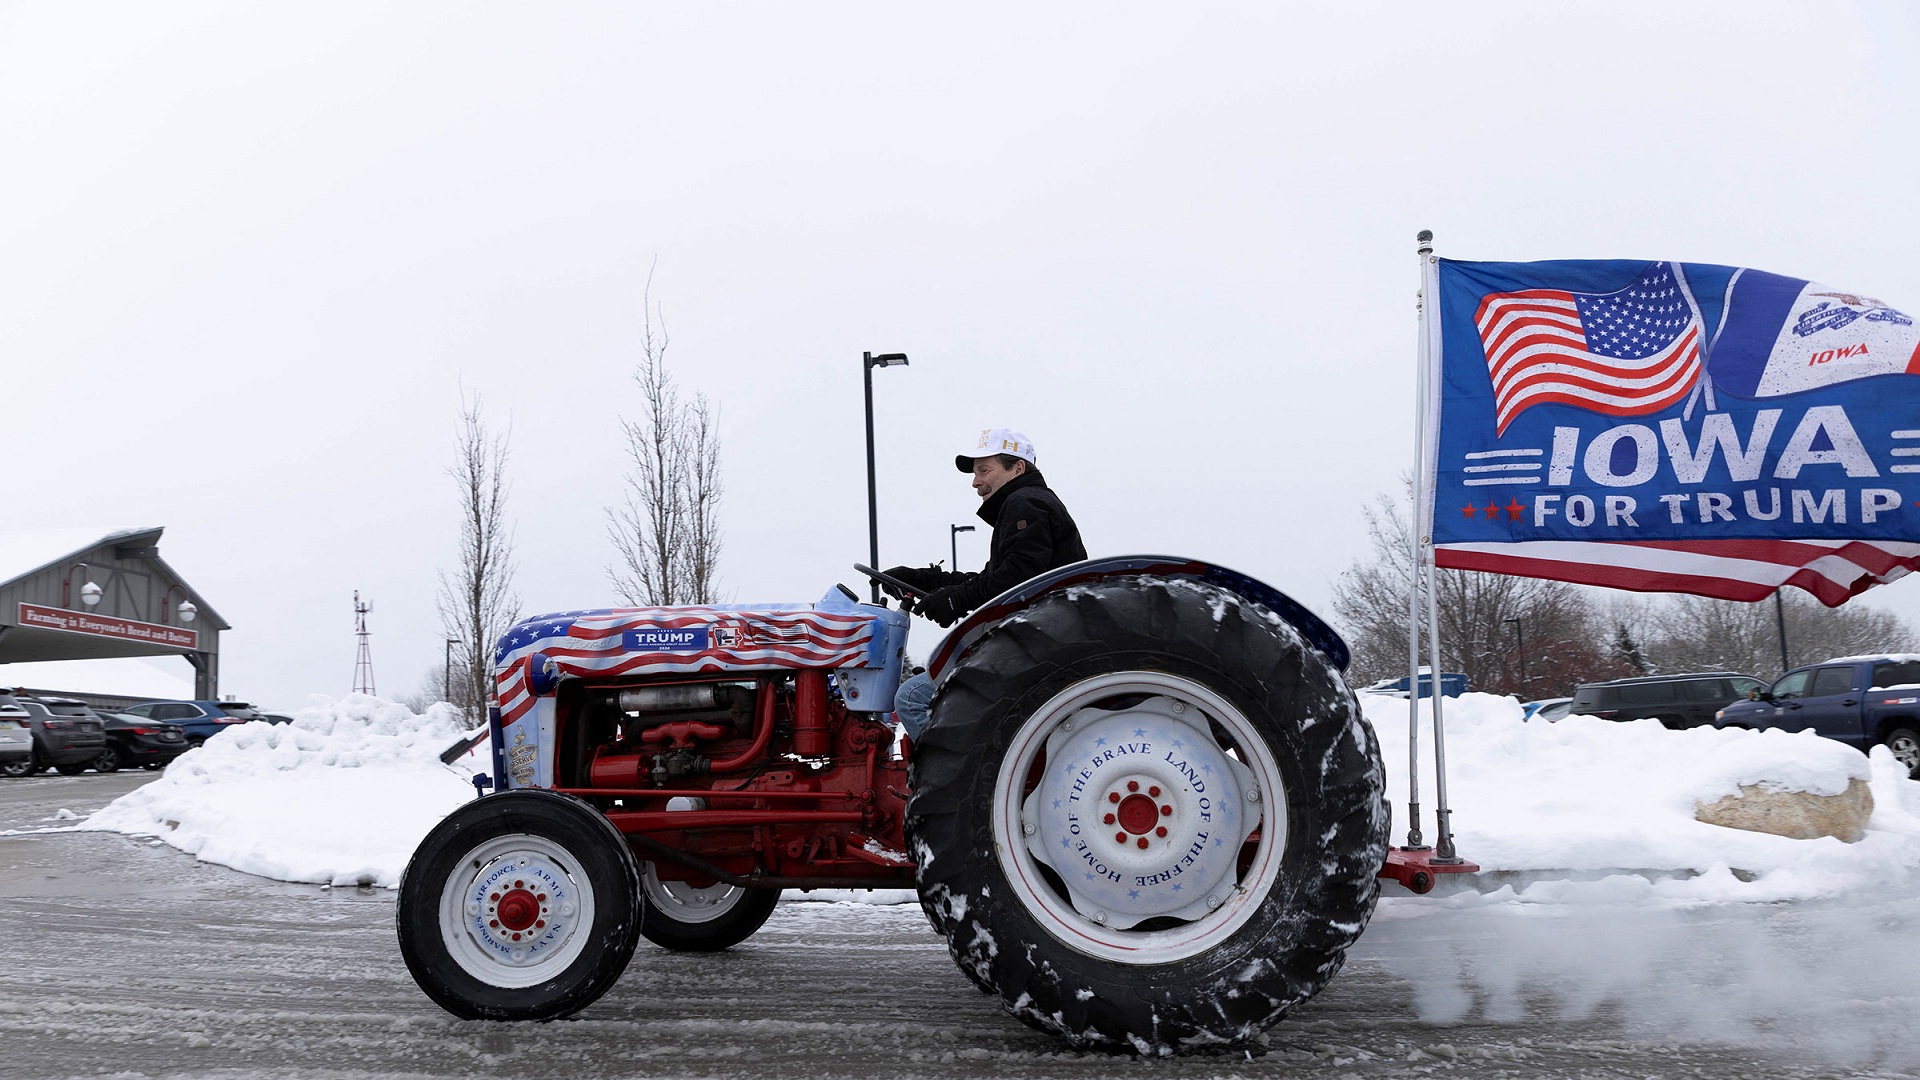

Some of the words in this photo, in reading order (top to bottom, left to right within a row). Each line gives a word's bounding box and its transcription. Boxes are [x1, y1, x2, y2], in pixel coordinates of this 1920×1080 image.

[1808, 343, 1868, 366] IOWA
[1547, 405, 1881, 488] IOWA
[1534, 494, 1640, 527] FOR
[1659, 487, 1902, 525] TRUMP
[27, 610, 67, 628] Farming
[69, 616, 78, 627] is
[79, 617, 126, 634] Everyone's
[127, 624, 151, 638] Bread
[152, 630, 168, 640] and
[168, 631, 192, 644] Butter
[635, 633, 695, 643] TRUMP
[1092, 743, 1152, 769] BRAVE
[1164, 751, 1206, 794] LAND
[1069, 767, 1093, 803] THE
[1069, 812, 1080, 836] OF
[1199, 796, 1211, 823] OF
[1075, 839, 1122, 883] HOME
[1181, 831, 1209, 867] THE
[476, 884, 487, 904] AIR
[487, 864, 516, 886] FORCE
[534, 869, 564, 898] ARMY
[1135, 862, 1183, 887] FREE
[476, 916, 511, 954] MARINES
[530, 923, 562, 953] NAVY
